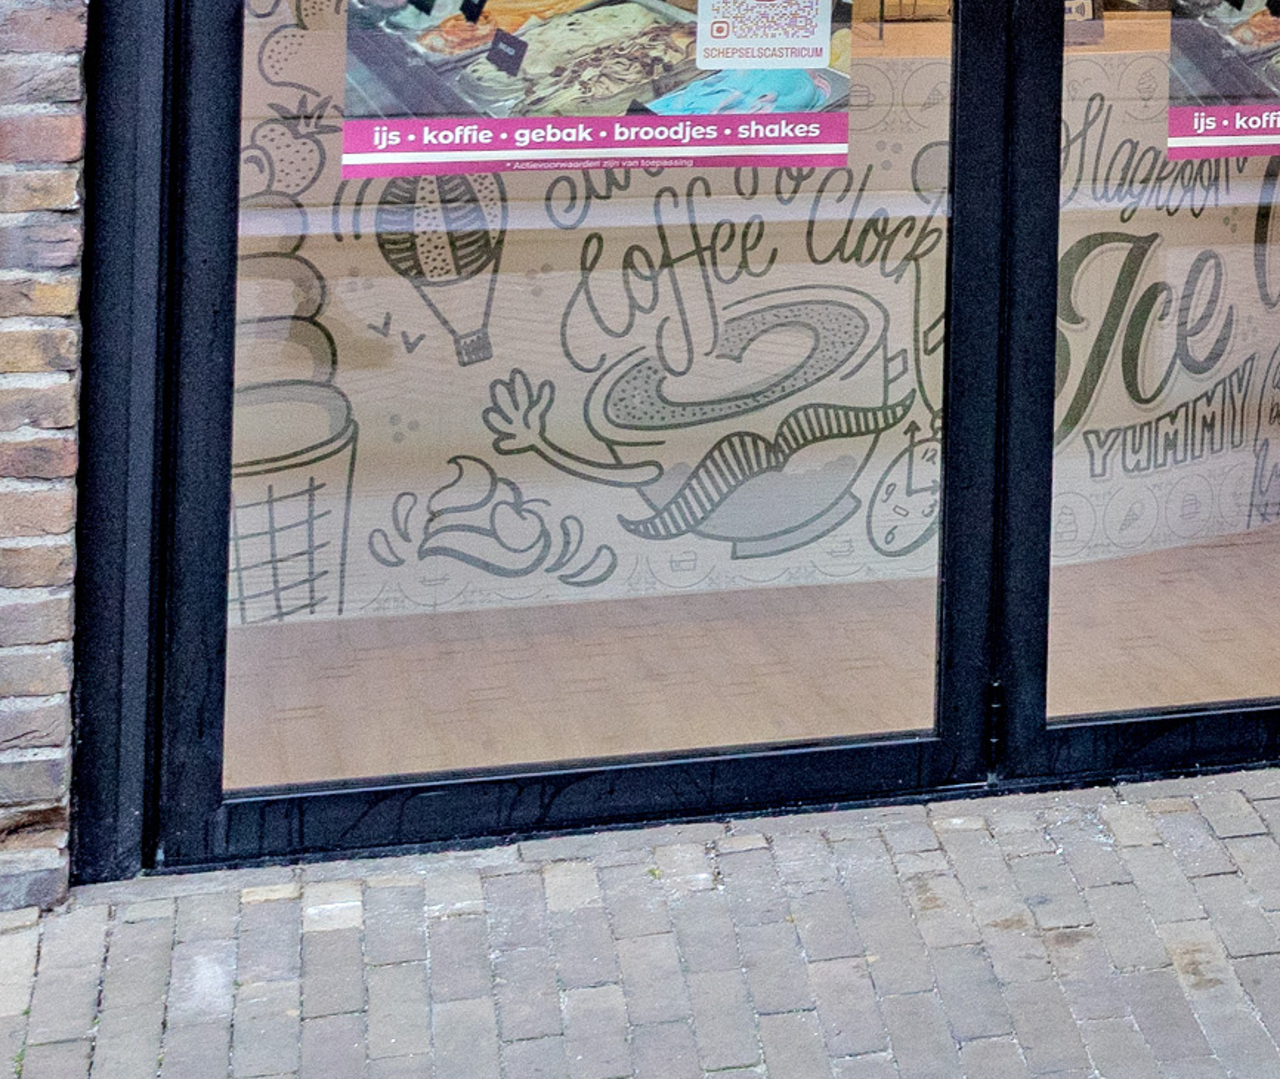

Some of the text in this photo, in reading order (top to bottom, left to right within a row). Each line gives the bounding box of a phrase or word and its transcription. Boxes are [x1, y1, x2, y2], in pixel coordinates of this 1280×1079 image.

[703, 46, 823, 59] SCHEPSELSCASTRICUM
[1193, 112, 1216, 133] ijs
[373, 120, 820, 149] ijs koffie gebak broodjes shakes
[513, 160, 601, 170] Actievoorwaarden
[620, 159, 639, 168] van
[640, 157, 694, 169] toepassing
[560, 183, 778, 374] Coffee
[1056, 231, 1234, 447] Ice
[1083, 352, 1258, 478] YUMMY
[921, 447, 938, 465] 12
[881, 482, 897, 503] 9
[884, 525, 898, 545] 6
